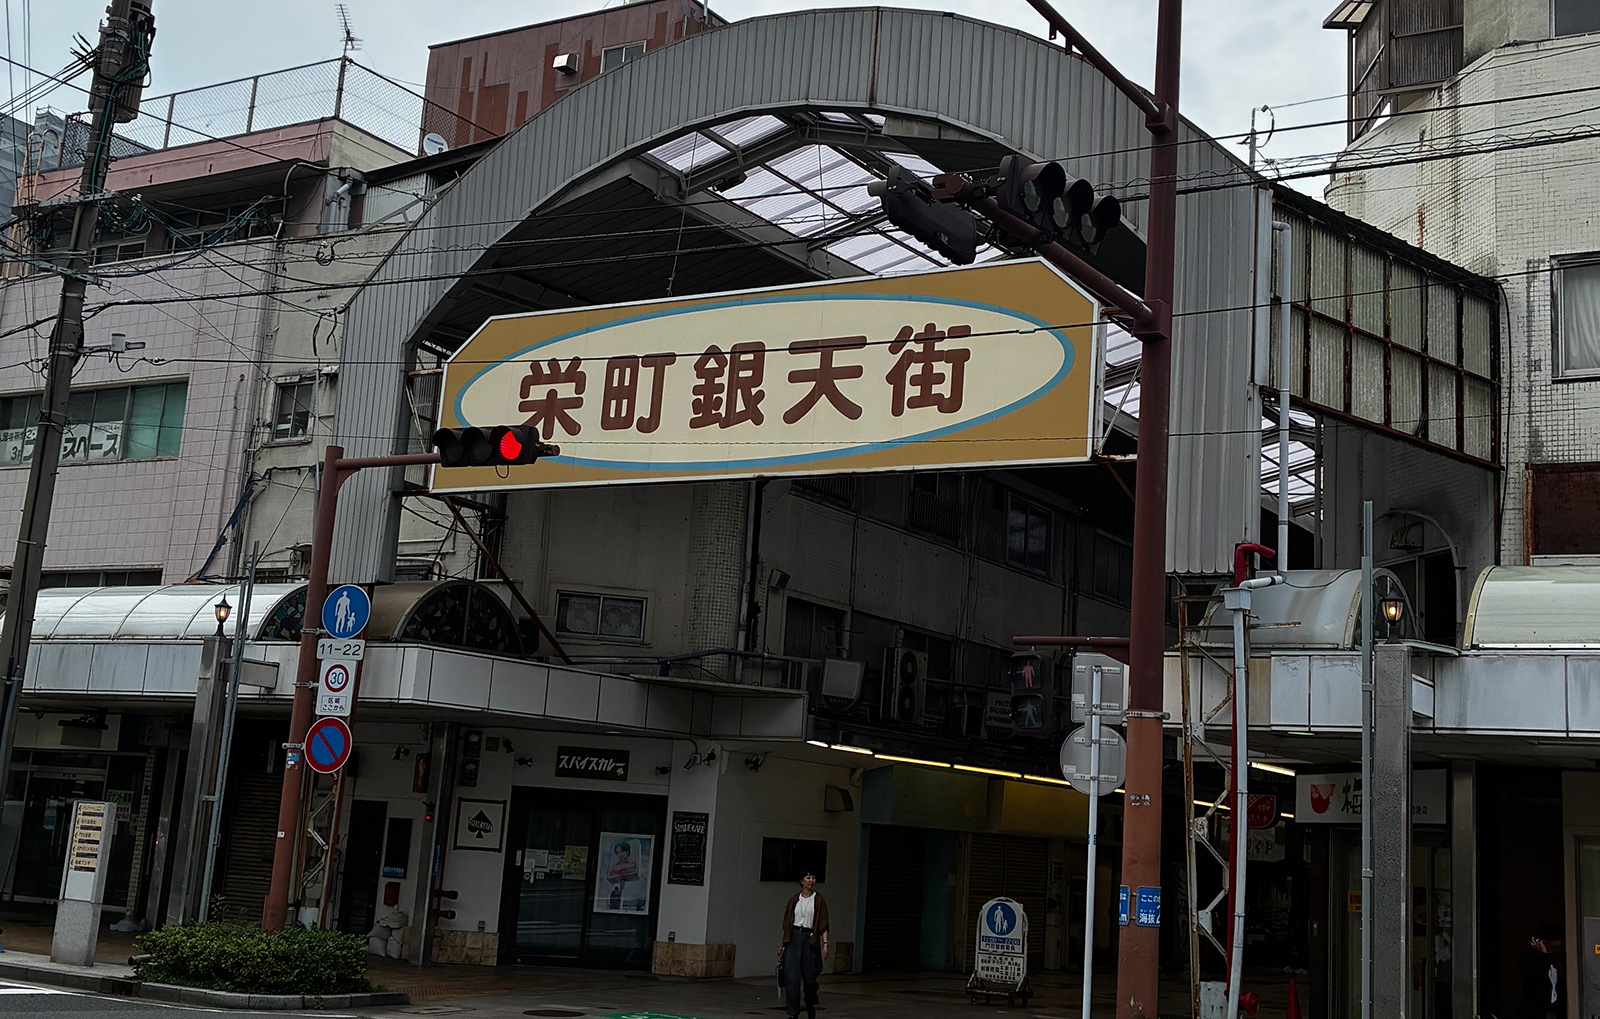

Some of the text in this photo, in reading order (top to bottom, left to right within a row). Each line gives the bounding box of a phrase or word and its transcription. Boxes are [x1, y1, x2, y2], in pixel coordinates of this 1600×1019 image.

[518, 322, 972, 440] 栄町銀天街
[320, 643, 361, 656] 11-22
[330, 671, 345, 685] 30
[322, 704, 345, 712] ここから
[558, 755, 627, 772] スパイスカレー
